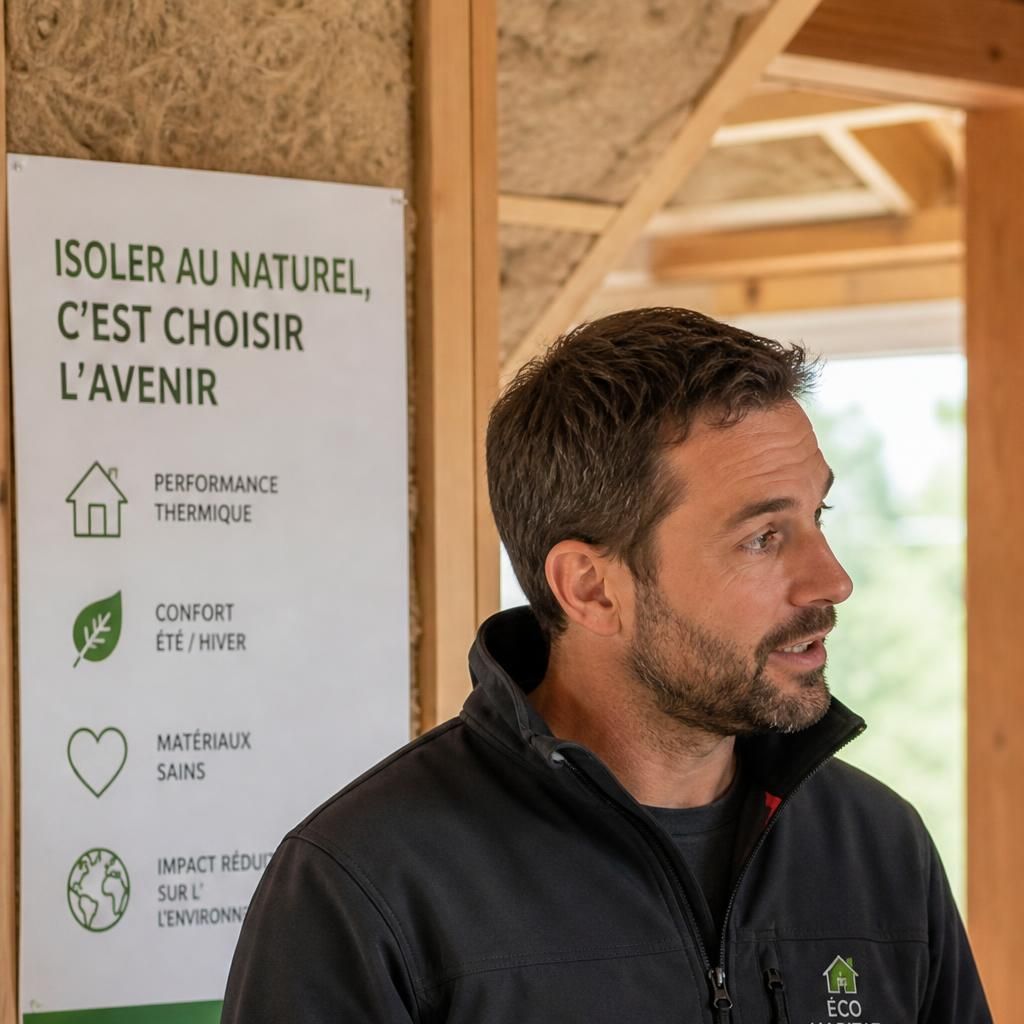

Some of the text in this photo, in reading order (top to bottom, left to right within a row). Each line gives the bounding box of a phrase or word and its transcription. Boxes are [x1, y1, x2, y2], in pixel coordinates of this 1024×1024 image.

[54, 238, 371, 302] ISOLER AU NATUREL,
[58, 301, 304, 352] C’EST CHOISIR
[60, 362, 218, 406] L’AVENIR
[155, 473, 278, 494] PERFORMANCE
[154, 503, 251, 525] THERMIQUE
[155, 603, 234, 622] CONFORT
[156, 629, 183, 651] ÉTÉ
[199, 633, 246, 651] HIVER
[157, 729, 251, 751] MATÉRIAUX
[157, 762, 205, 781] SAINS
[158, 855, 216, 875] IMPACT
[158, 884, 188, 902] SUR
[826, 996, 862, 1018] ÉCO
